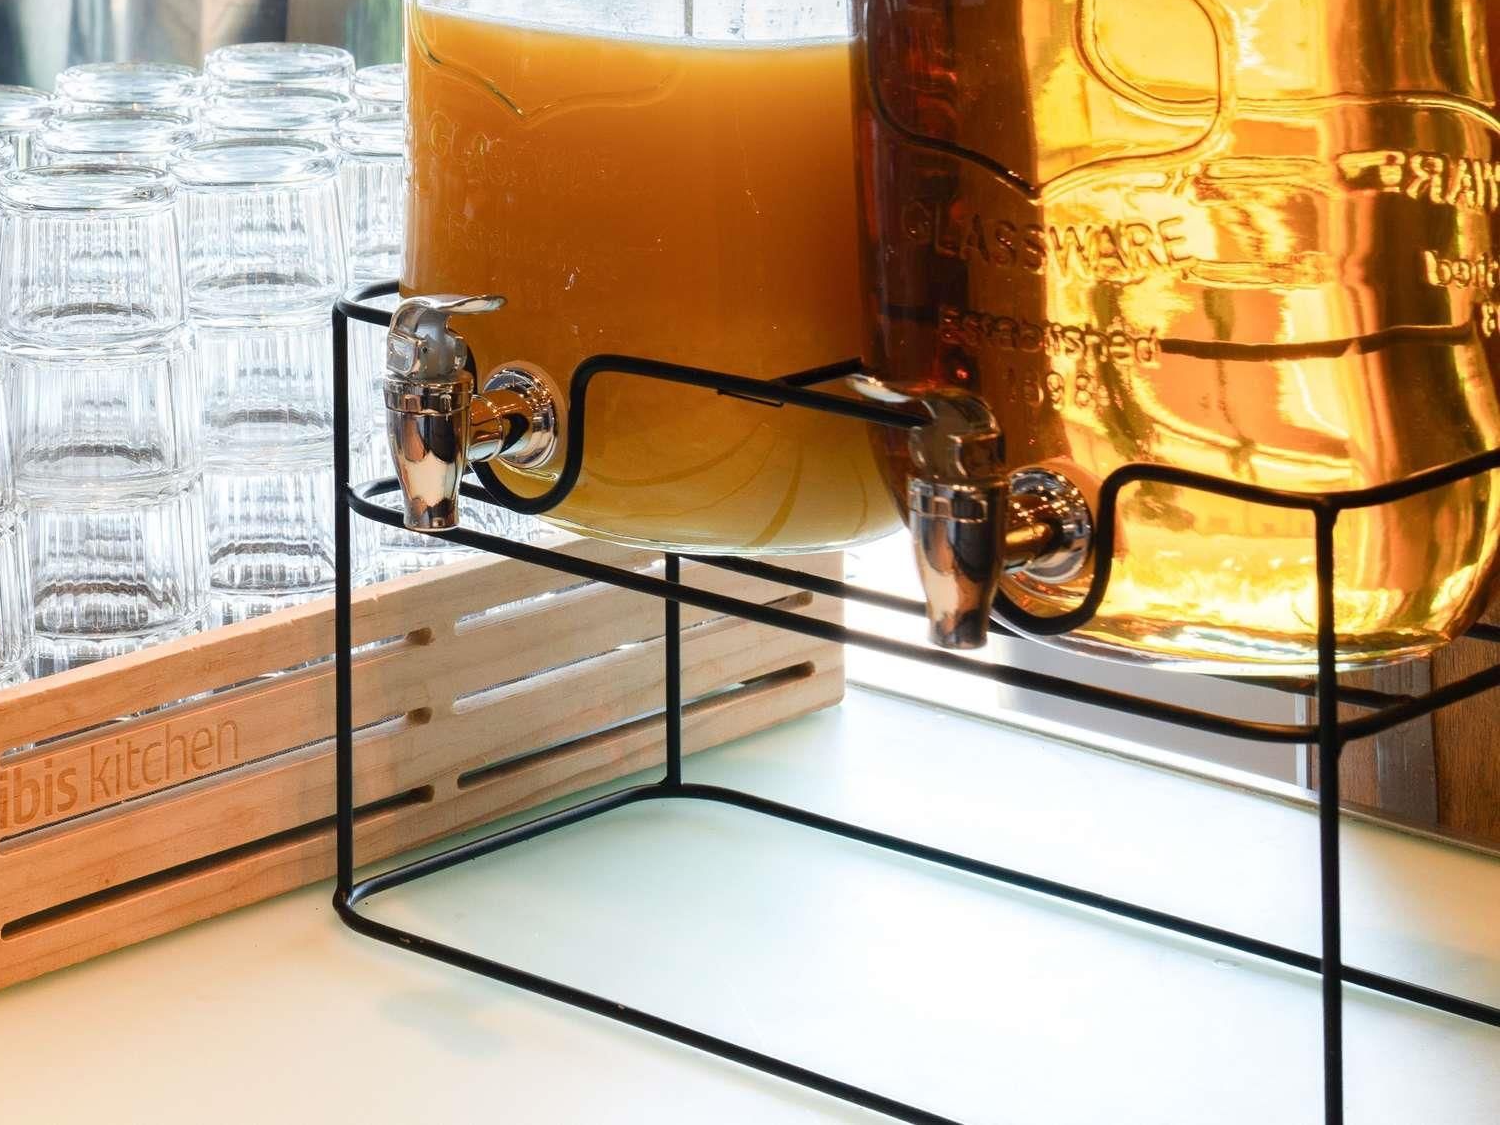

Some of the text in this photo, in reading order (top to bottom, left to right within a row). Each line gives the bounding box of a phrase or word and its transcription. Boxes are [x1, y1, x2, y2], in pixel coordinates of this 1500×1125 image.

[901, 201, 1192, 271] GLASSWARE
[0, 718, 239, 830] ibis kitchen
